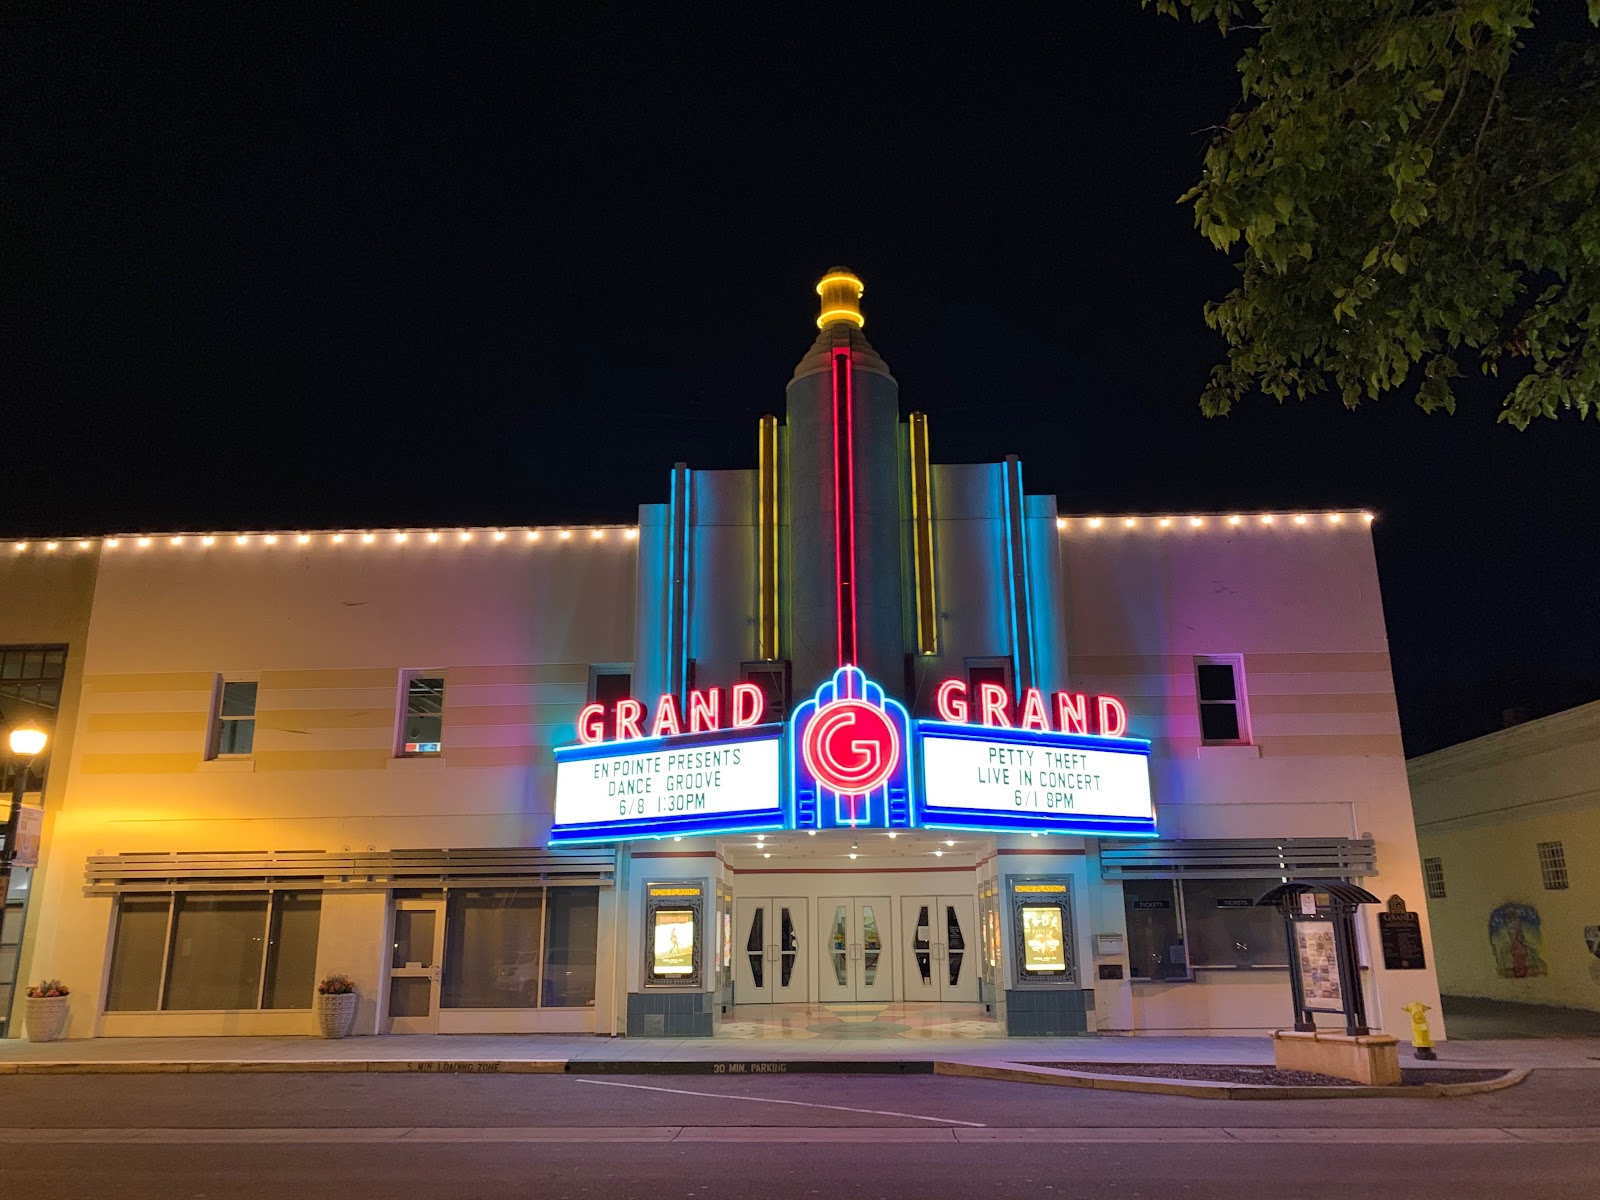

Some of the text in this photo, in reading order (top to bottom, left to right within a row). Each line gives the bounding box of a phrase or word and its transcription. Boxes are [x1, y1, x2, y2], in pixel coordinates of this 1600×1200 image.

[577, 683, 764, 744] GRAND
[937, 680, 1127, 737] GRAND
[816, 711, 881, 781] G
[594, 748, 741, 779] EN POINTE PRESENTS
[988, 747, 1087, 770] PETTY THEFT
[608, 770, 721, 797] DANCE GROOVE
[978, 767, 1101, 790] LIVE IN CONCERT
[619, 792, 706, 815] 6/8 1:30PM
[1014, 789, 1074, 809] 6/1 8PM
[1384, 913, 1414, 921] GRAND
[407, 1062, 413, 1071] 5
[418, 1062, 433, 1072] MIN
[478, 1063, 500, 1072] ZONE
[713, 1063, 787, 1073] 30 MIN. PARKING
